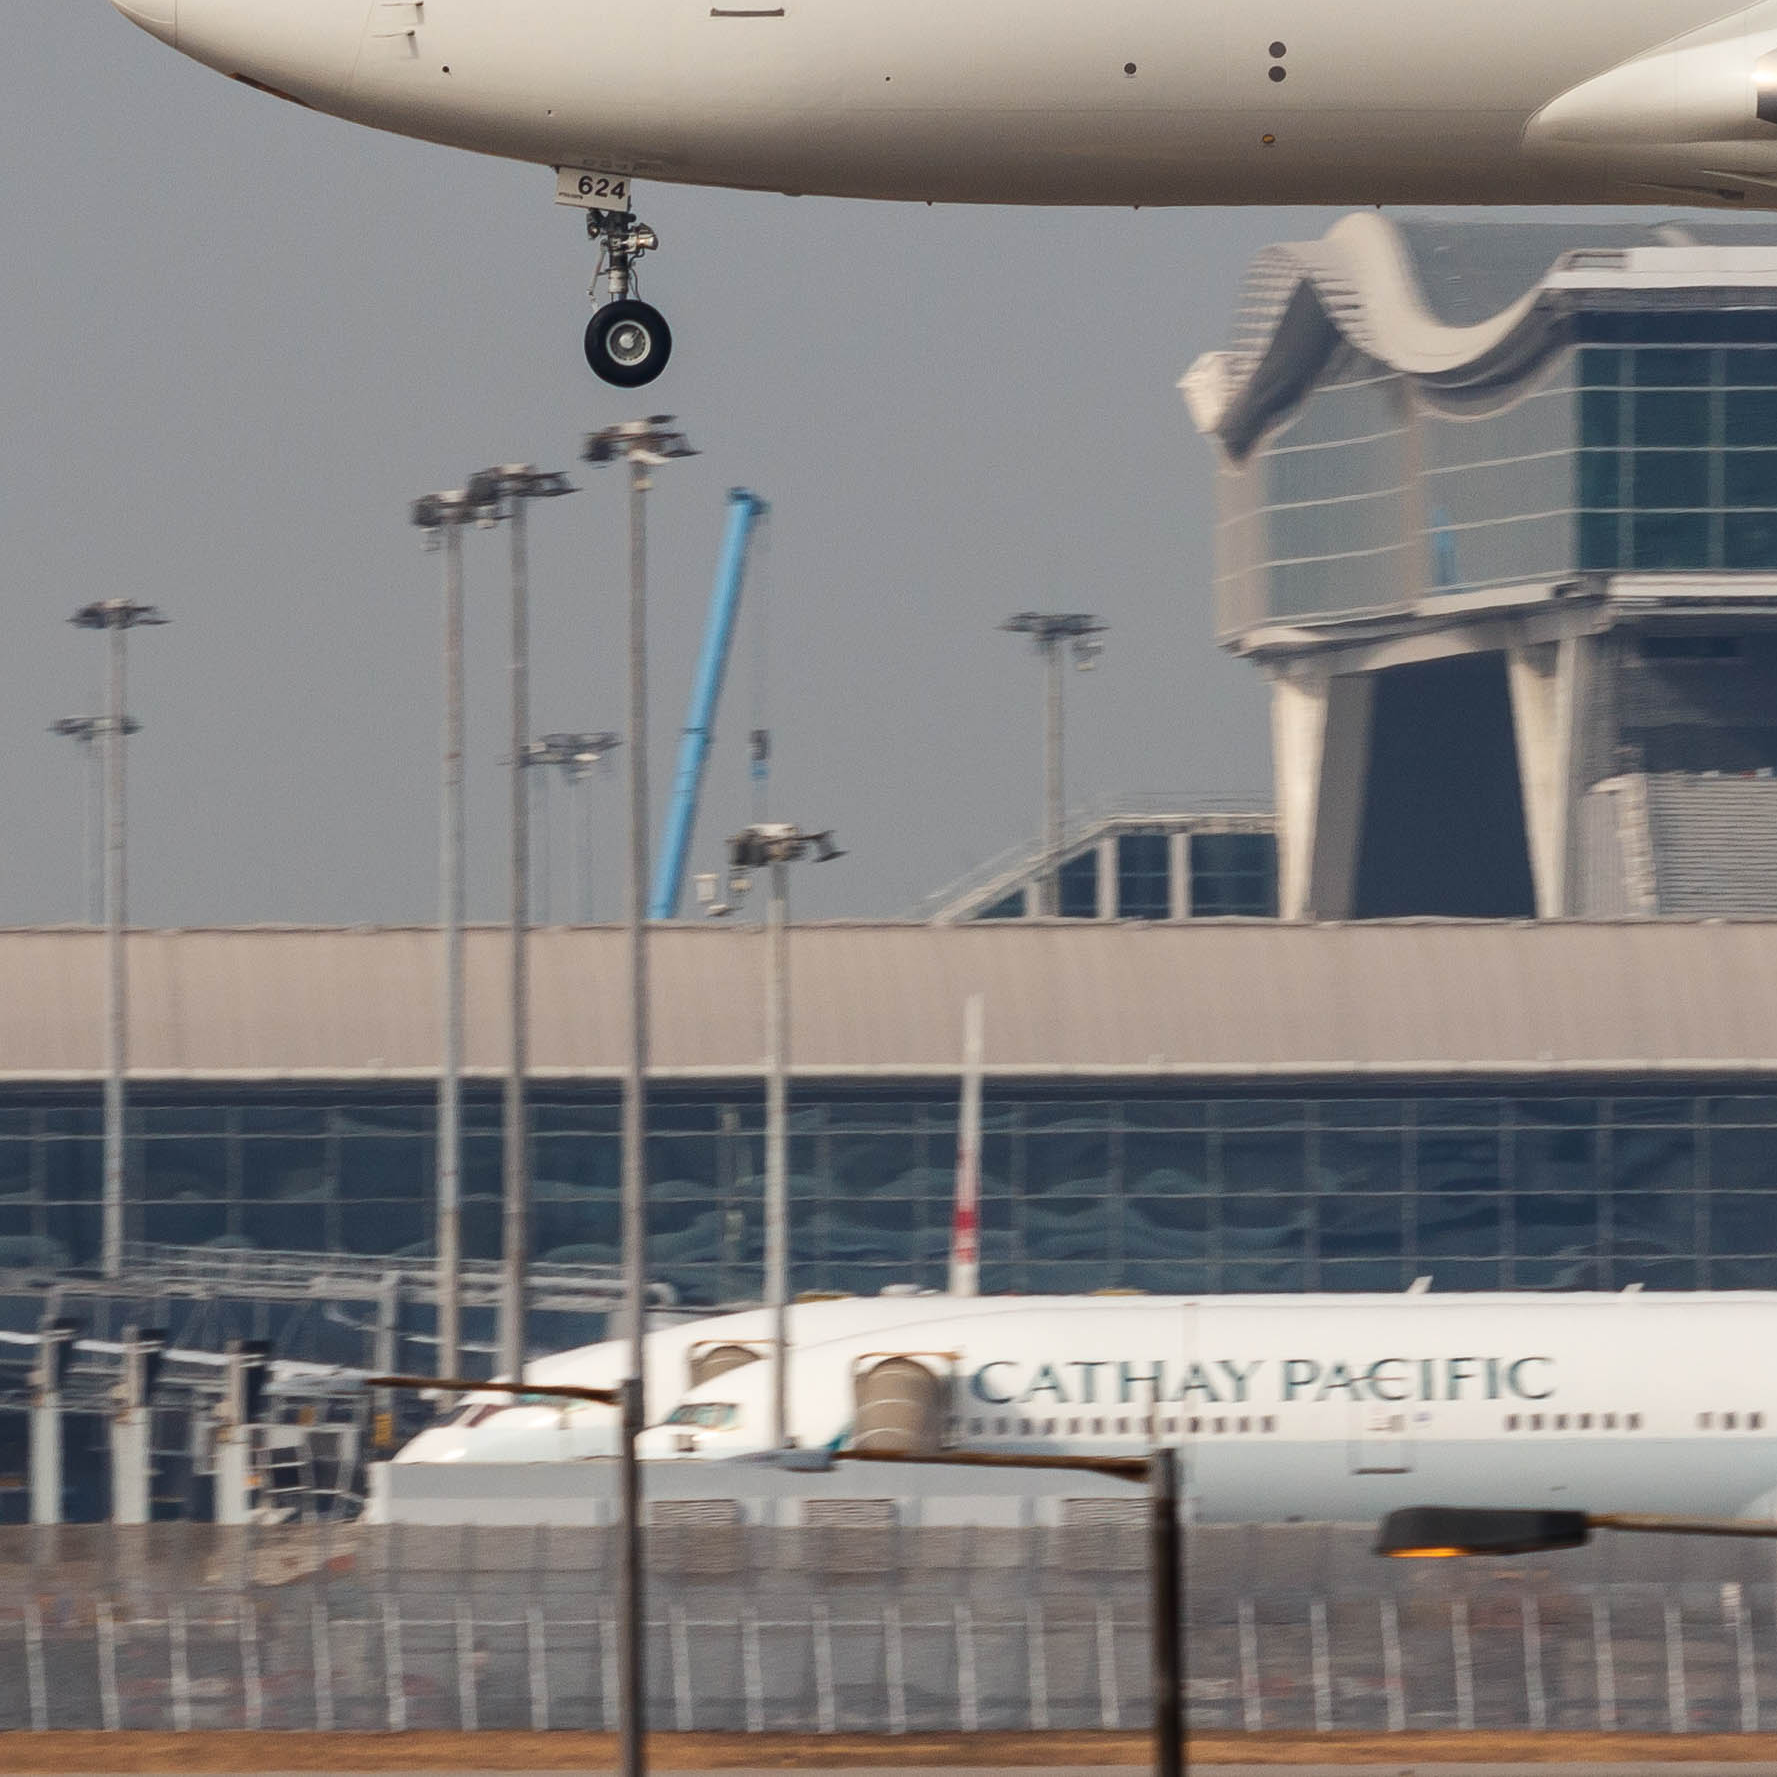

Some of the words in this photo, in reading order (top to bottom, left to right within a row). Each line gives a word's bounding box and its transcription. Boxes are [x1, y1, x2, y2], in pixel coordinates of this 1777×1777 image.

[578, 175, 626, 200] 624
[970, 1359, 1265, 1404] CATHAY
[1279, 1356, 1555, 1402] PACIFIC
